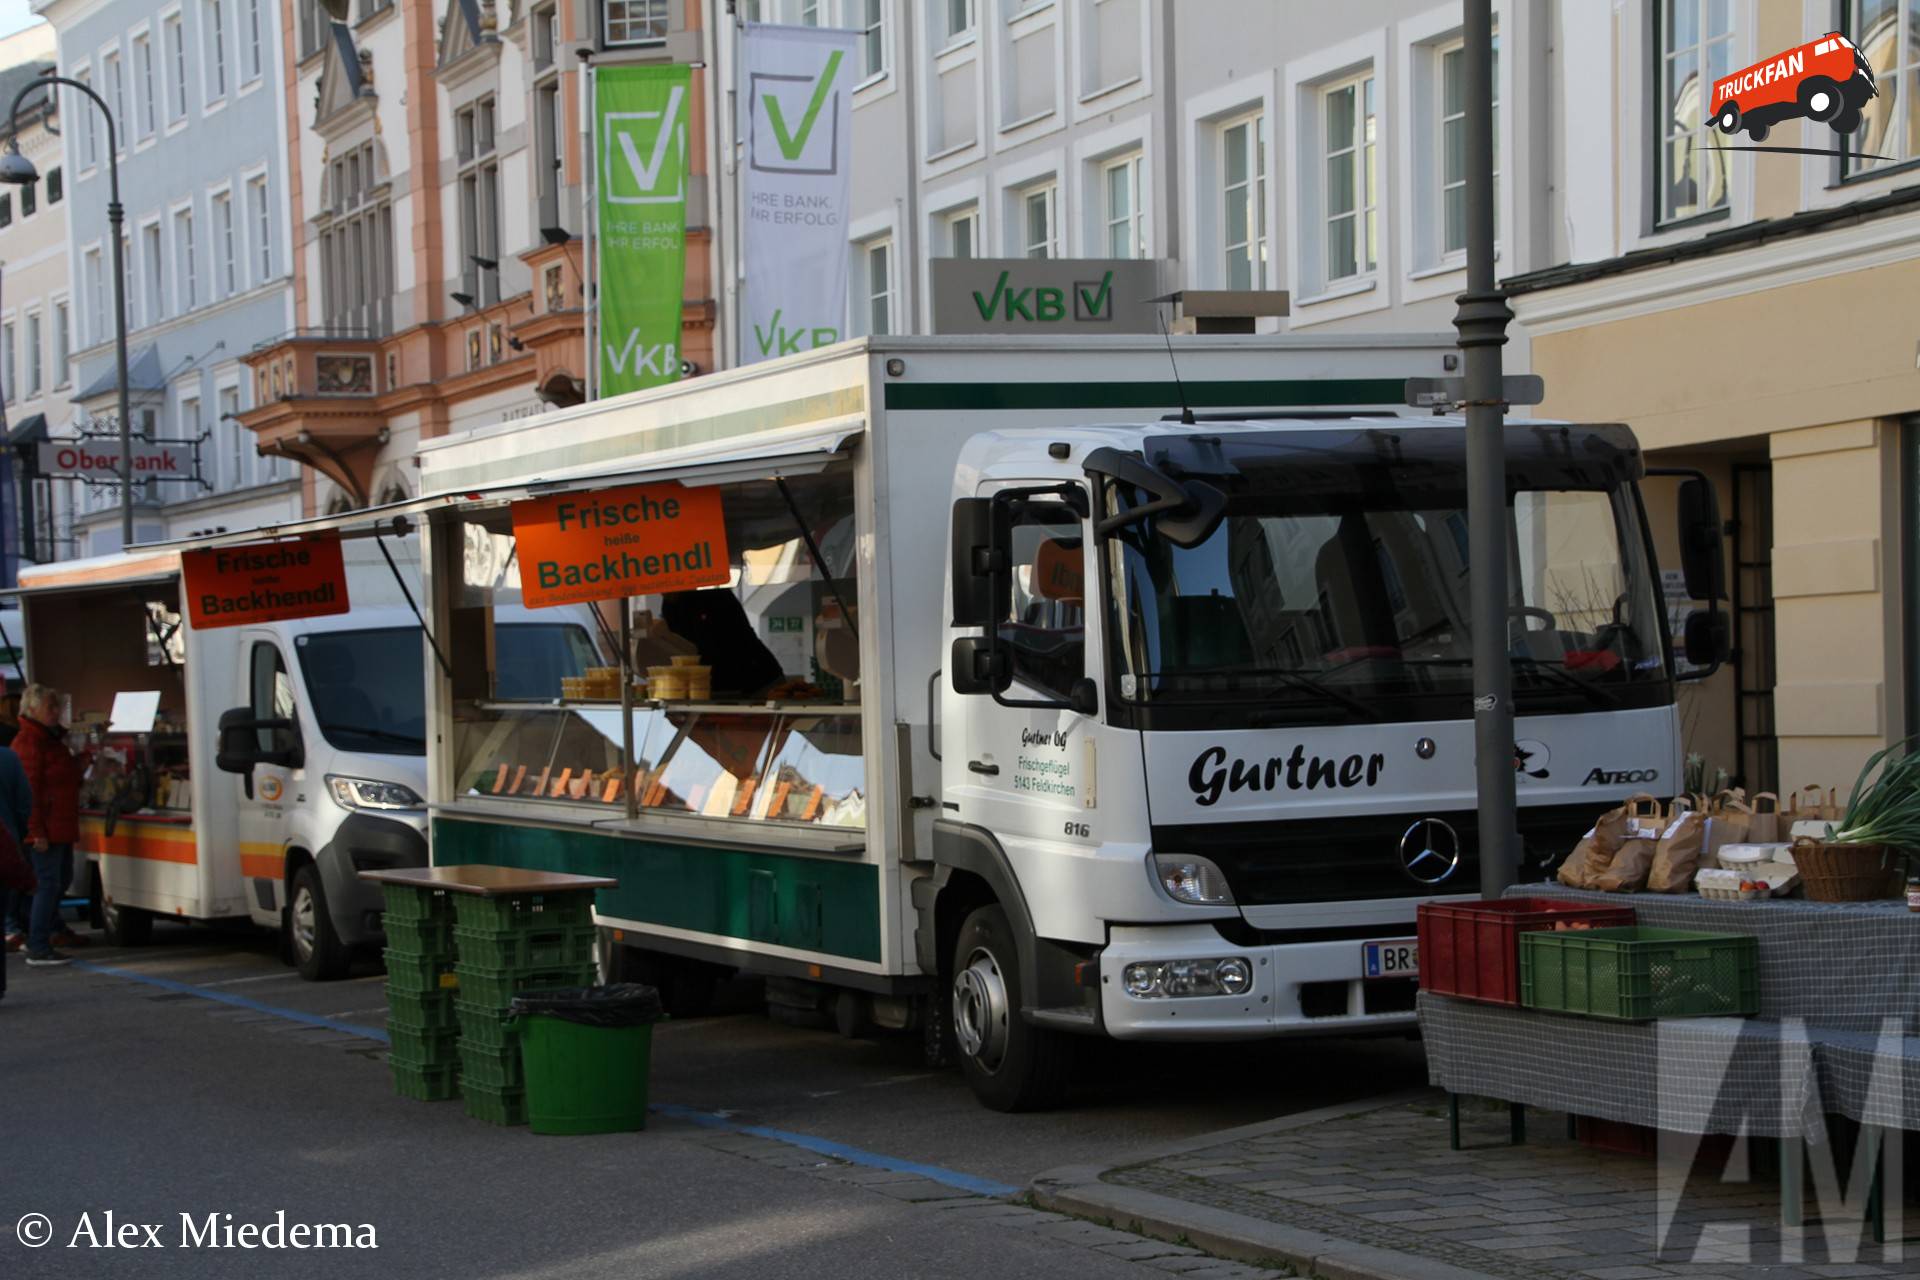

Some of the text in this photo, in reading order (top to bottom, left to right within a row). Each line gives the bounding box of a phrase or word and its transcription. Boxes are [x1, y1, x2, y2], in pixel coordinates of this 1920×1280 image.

[973, 271, 1066, 321] VKB
[607, 327, 677, 376] VKB
[57, 449, 177, 471] Oberank
[557, 496, 681, 531] Frische
[604, 533, 640, 547] heiße
[216, 547, 311, 574] Frische
[537, 542, 713, 590] Backhendl
[201, 582, 336, 616] Backhendl
[1021, 727, 1052, 748] Gurtner
[1018, 755, 1070, 778] Frischgeflügel
[1188, 744, 1384, 806] Gurtner
[1032, 777, 1076, 796] Feldkirchen
[1064, 821, 1091, 837] 816
[1384, 947, 1409, 970] BR
